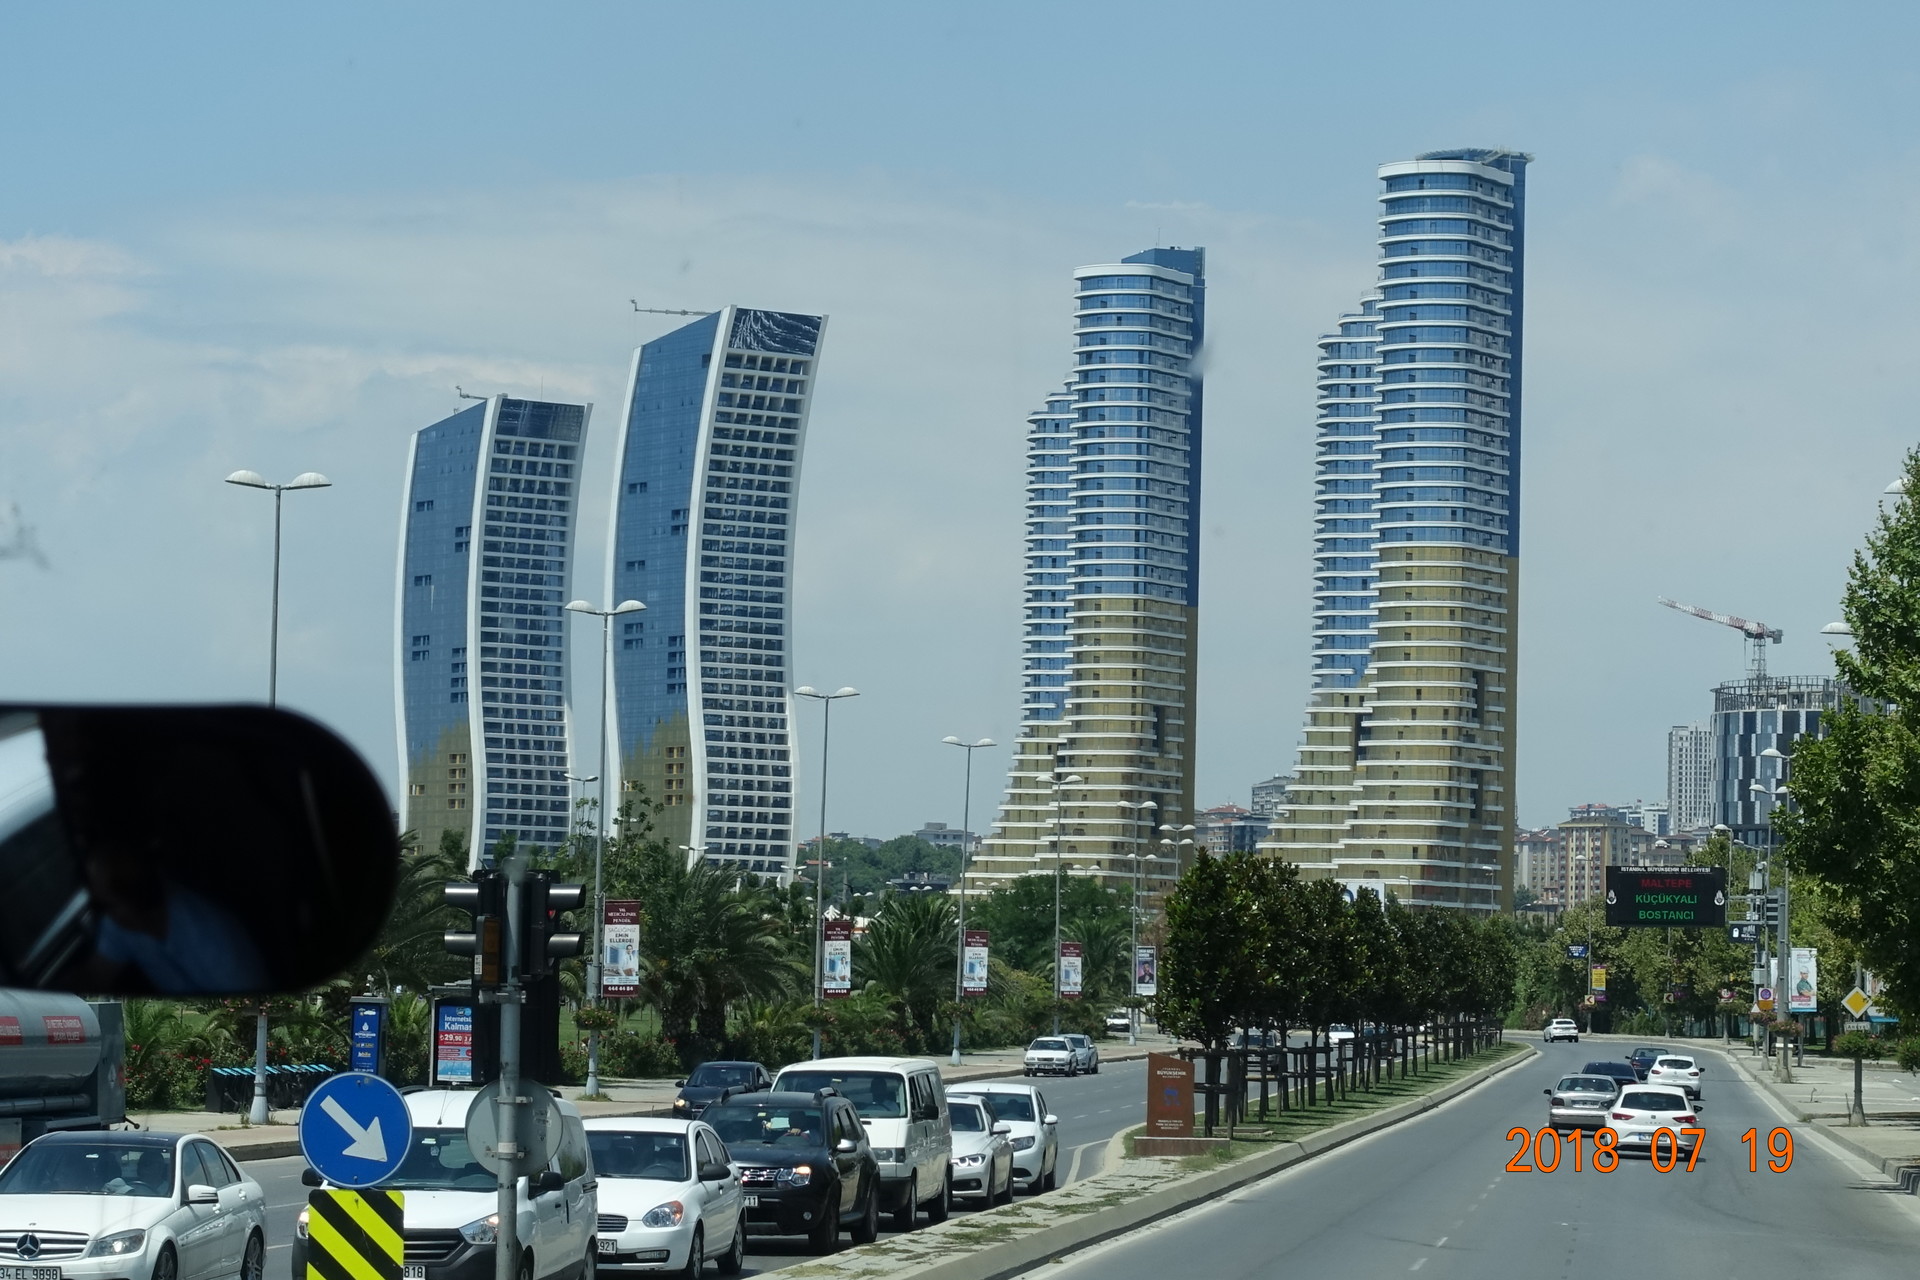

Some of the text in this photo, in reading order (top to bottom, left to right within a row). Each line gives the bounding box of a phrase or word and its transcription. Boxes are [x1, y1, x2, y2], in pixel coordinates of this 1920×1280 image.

[1641, 879, 1692, 888] MALTEPE
[1635, 892, 1697, 905] KÜÇÜKYALI
[1638, 910, 1694, 920] BOSTANCI
[598, 1241, 615, 1252] 921
[0, 1268, 58, 1280] 34 EL 9898
[404, 1266, 424, 1278] 818
